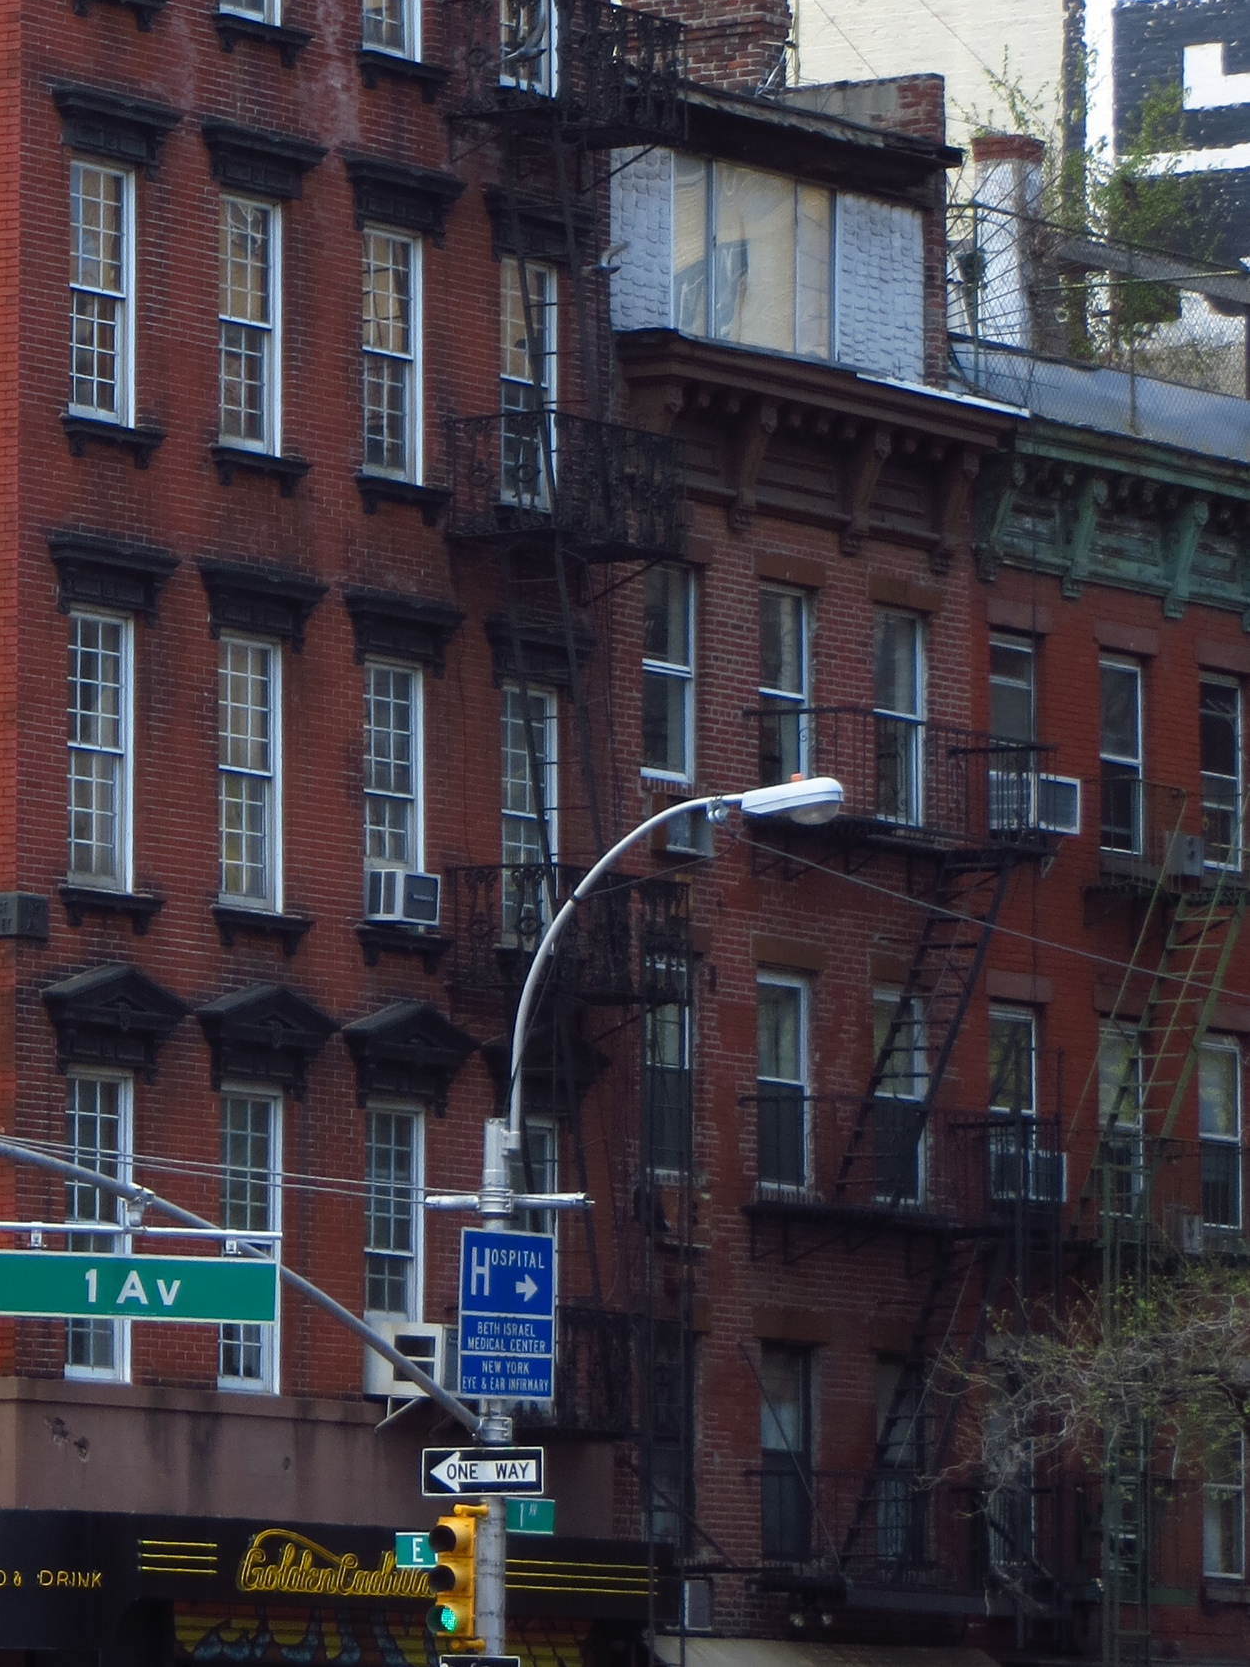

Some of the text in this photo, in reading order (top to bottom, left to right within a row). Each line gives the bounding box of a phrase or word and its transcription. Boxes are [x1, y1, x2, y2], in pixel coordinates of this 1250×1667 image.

[470, 1246, 546, 1297] HOSPITAL
[84, 1268, 98, 1303] 1
[477, 1321, 536, 1337] BETH ISRAEL
[467, 1336, 546, 1353] MEDICAL CENTER
[482, 1360, 530, 1375] NEW YORK
[462, 1376, 549, 1392] EYE & EAR INFIRMARY
[447, 1462, 530, 1480] ONE WAY
[519, 1502, 524, 1528] 1
[412, 1537, 424, 1563] E
[241, 1542, 337, 1594] Golden
[13, 1570, 22, 1587] &
[38, 1569, 103, 1587] DRINK
